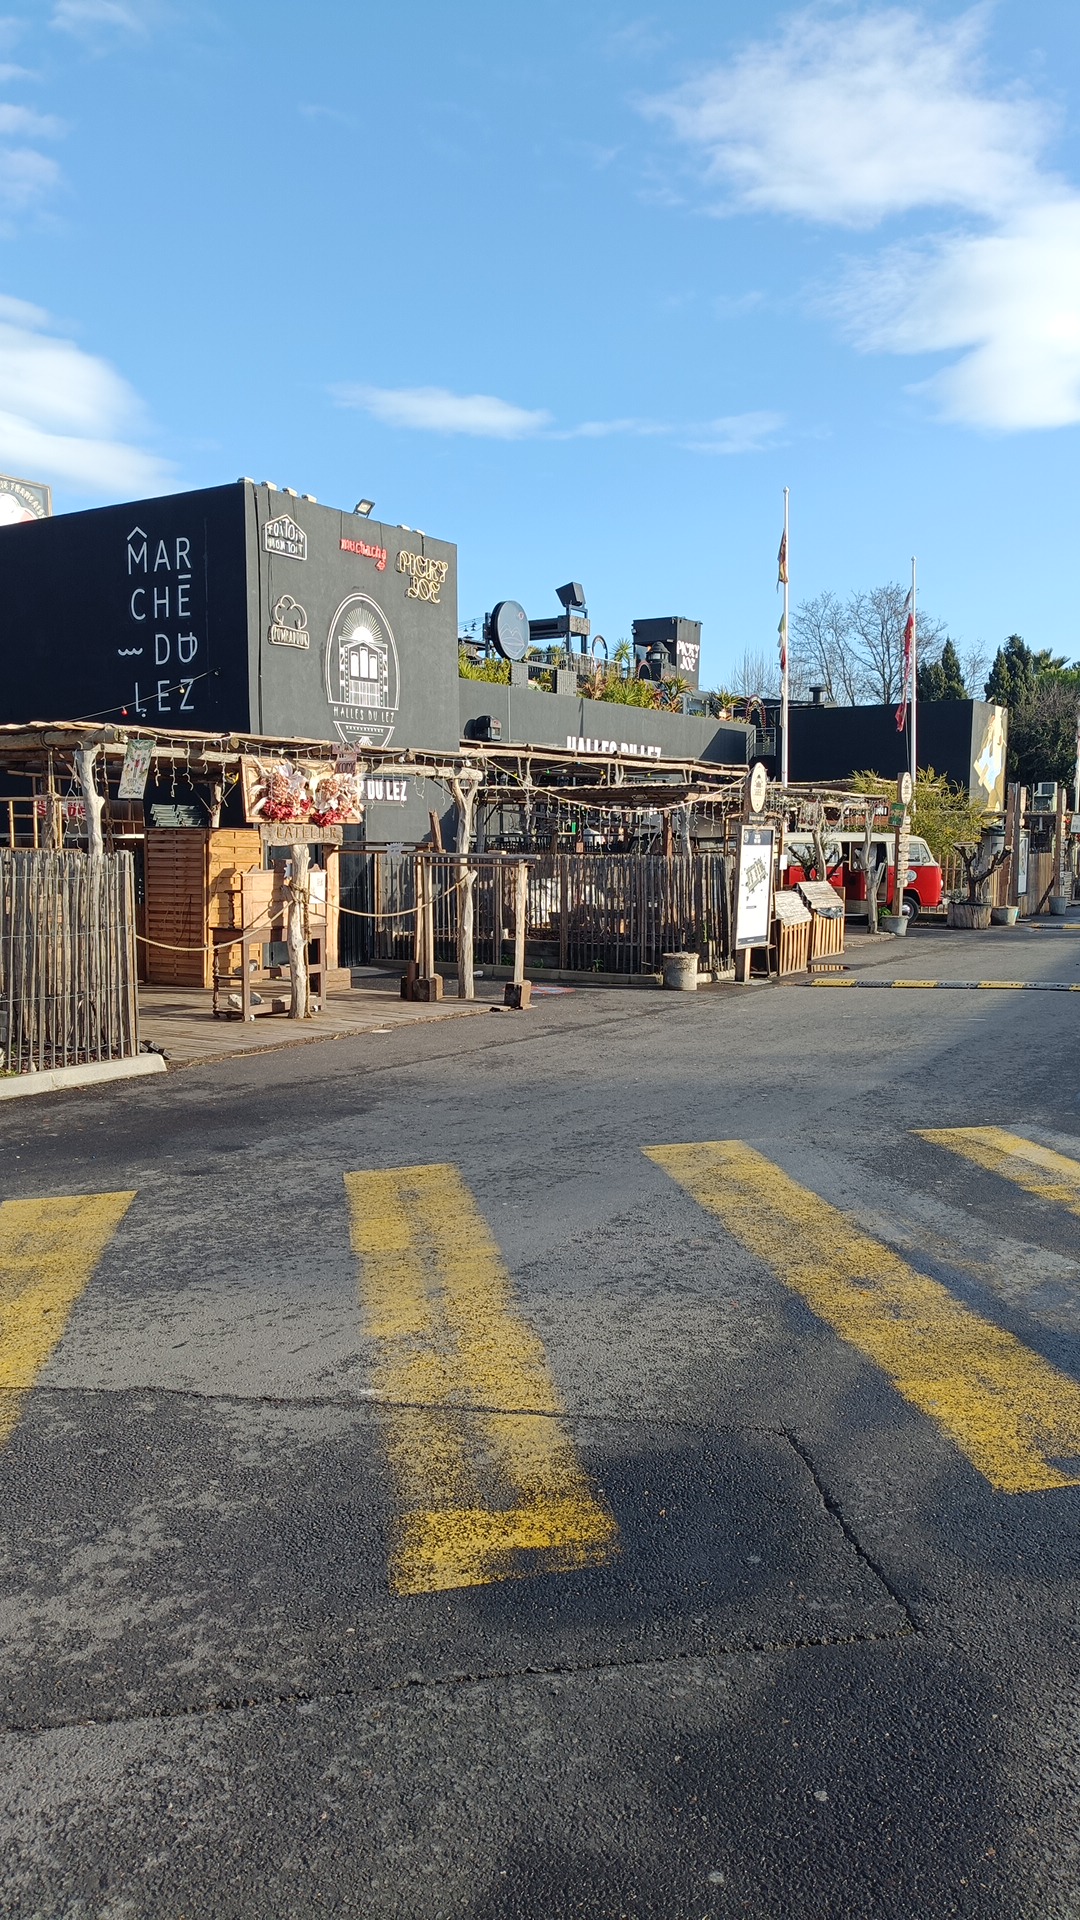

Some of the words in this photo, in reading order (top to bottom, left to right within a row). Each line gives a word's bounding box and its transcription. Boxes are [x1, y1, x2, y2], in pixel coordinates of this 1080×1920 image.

[127, 535, 191, 575] MAR
[340, 539, 387, 561] muchacha
[399, 550, 448, 582] PICKY
[408, 576, 441, 604] JOE
[155, 632, 198, 665] DU
[676, 640, 700, 658] PICKY
[680, 655, 696, 672] JOE
[135, 678, 194, 714] LEZ
[333, 705, 364, 721] HALLES
[368, 709, 378, 722] DU
[381, 711, 395, 723] LEZ
[367, 779, 384, 800] DU
[385, 780, 408, 801] LEZ
